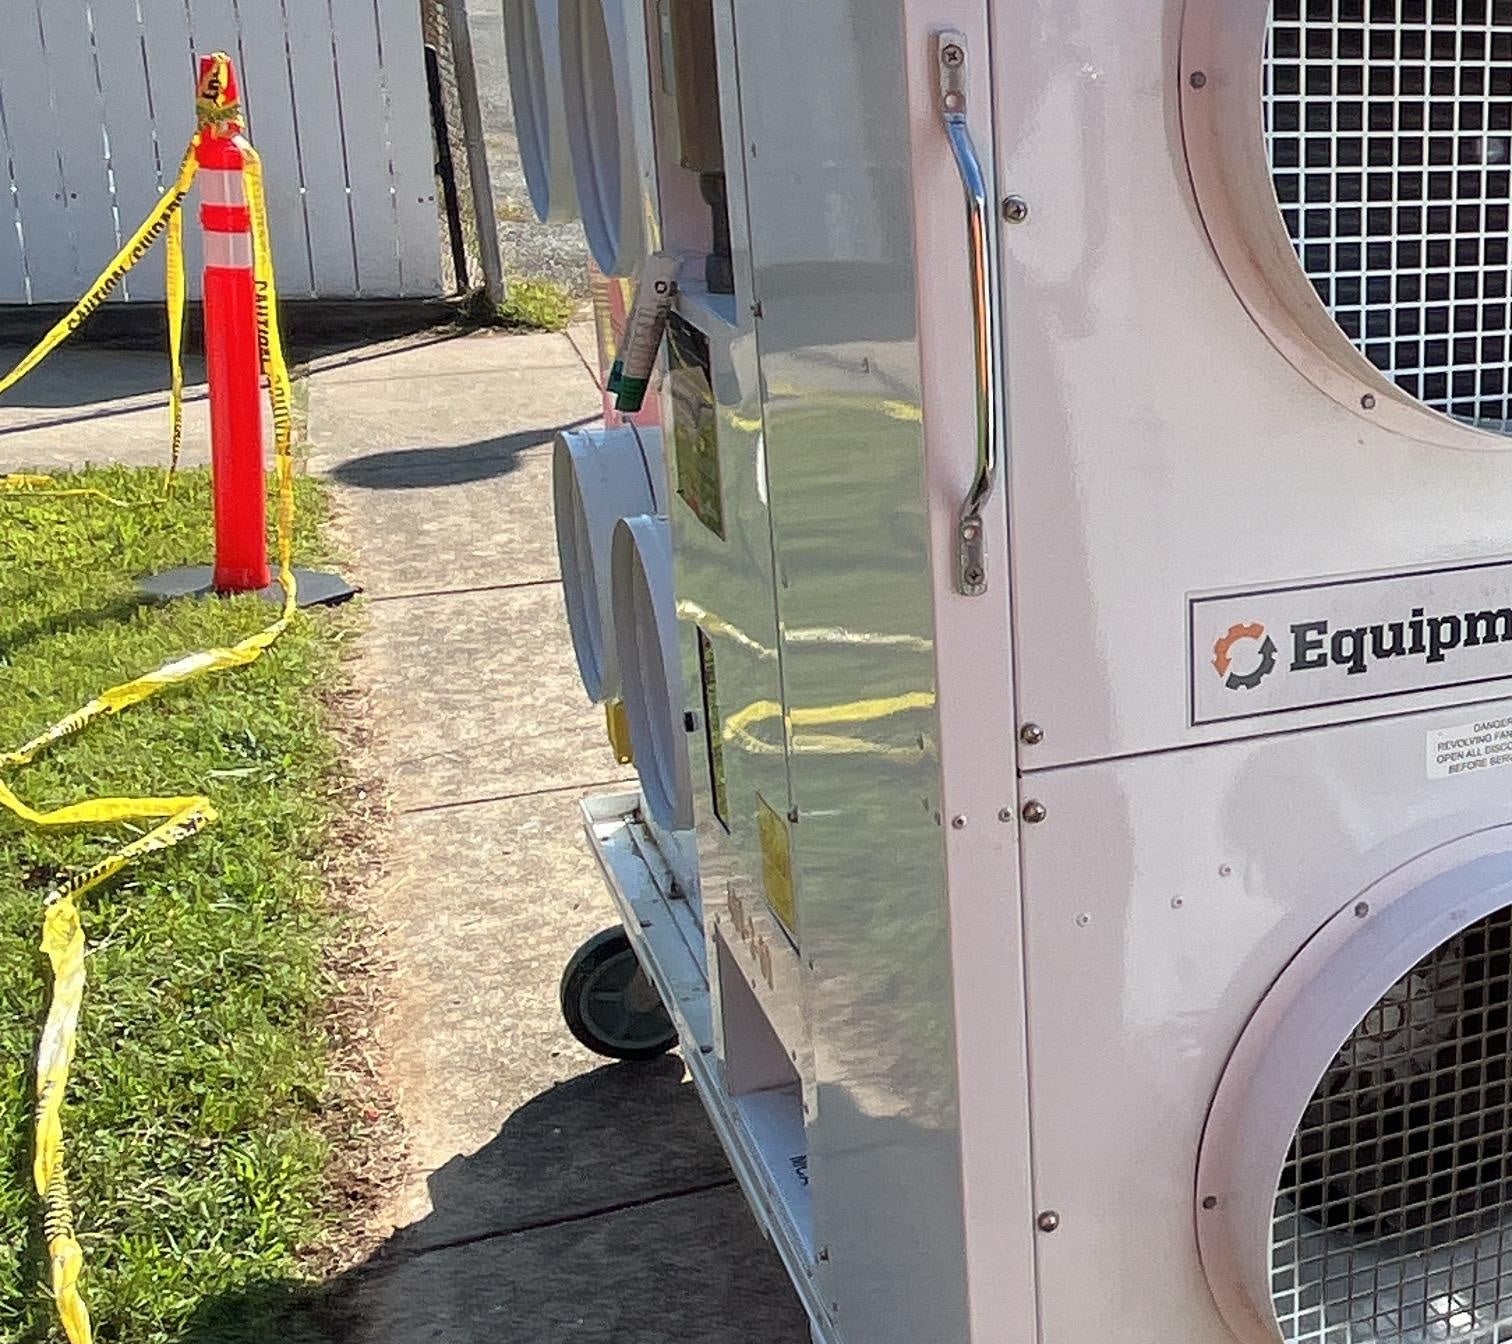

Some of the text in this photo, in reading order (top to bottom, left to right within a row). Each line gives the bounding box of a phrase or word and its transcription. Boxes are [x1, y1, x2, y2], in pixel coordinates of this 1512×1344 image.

[1437, 734, 1492, 752] REVOLVING
[1494, 729, 1512, 741] FAN
[1436, 751, 1464, 764] OPEN
[1466, 747, 1481, 758] ALL
[1448, 758, 1488, 774] BEFORE
